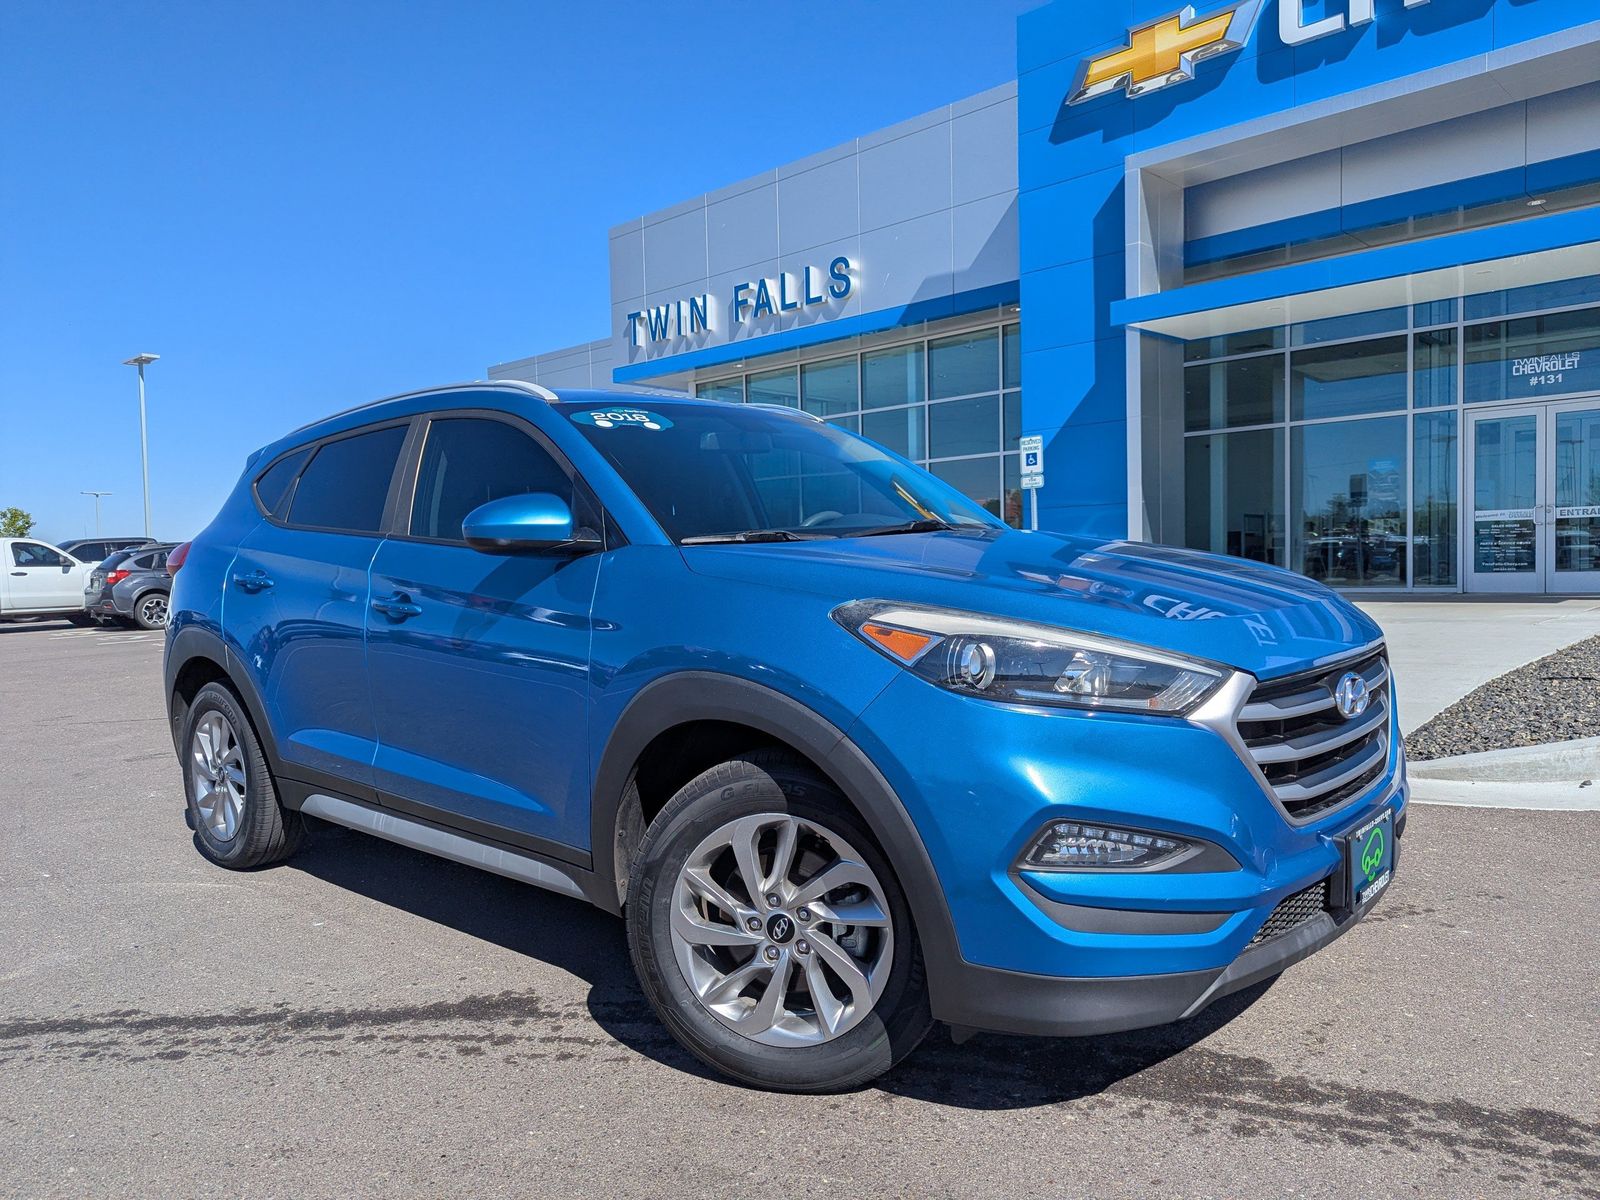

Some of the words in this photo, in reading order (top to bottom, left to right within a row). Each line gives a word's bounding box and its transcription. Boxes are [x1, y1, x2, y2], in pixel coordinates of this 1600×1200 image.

[627, 294, 712, 346] TWIN
[733, 256, 855, 322] FALLS
[1513, 359, 1579, 376] CHEVROLET
[1529, 373, 1563, 386] #131
[590, 412, 650, 422] 2018
[1559, 508, 1600, 517] ENTRA
